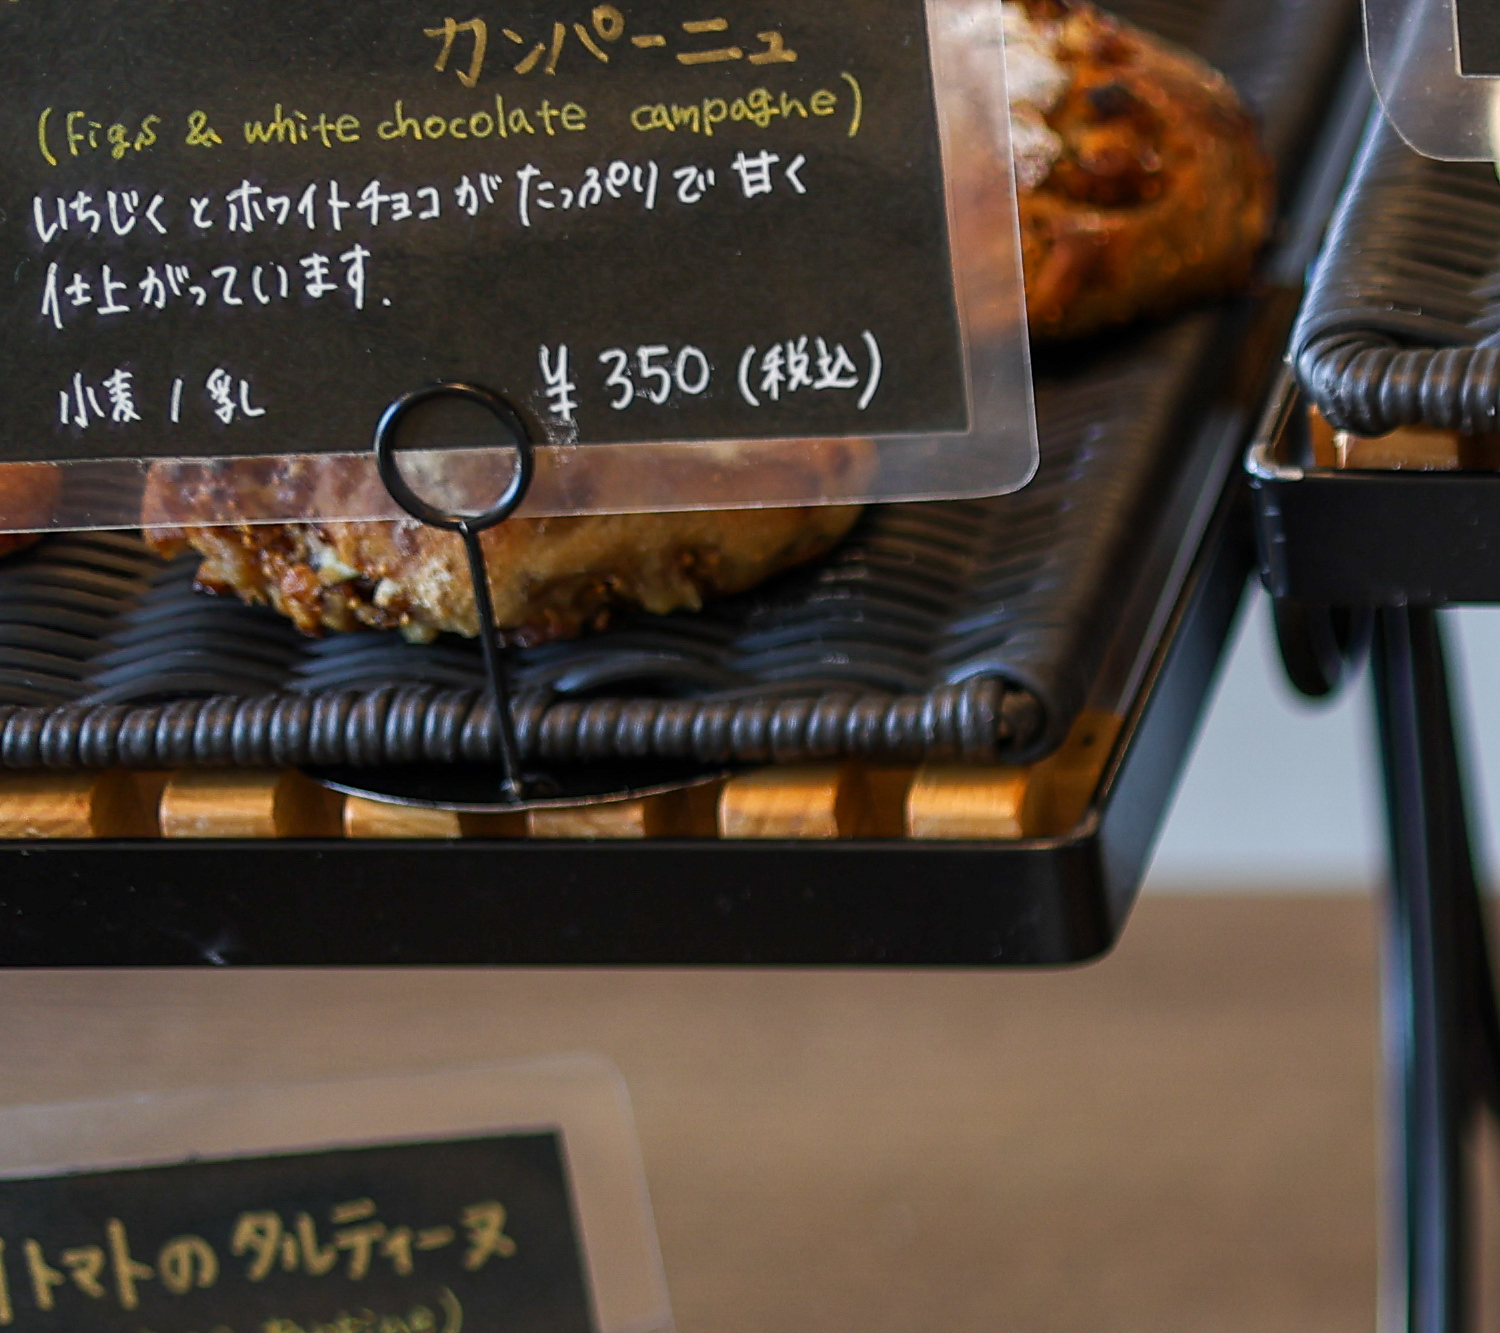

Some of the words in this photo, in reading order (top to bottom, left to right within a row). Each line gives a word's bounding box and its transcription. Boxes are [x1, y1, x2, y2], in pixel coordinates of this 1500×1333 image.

[424, 5, 798, 87] カンパーニュ
[185, 110, 223, 148] &
[244, 102, 361, 148] white
[377, 94, 588, 141] chocolate
[630, 71, 862, 138] campagne)
